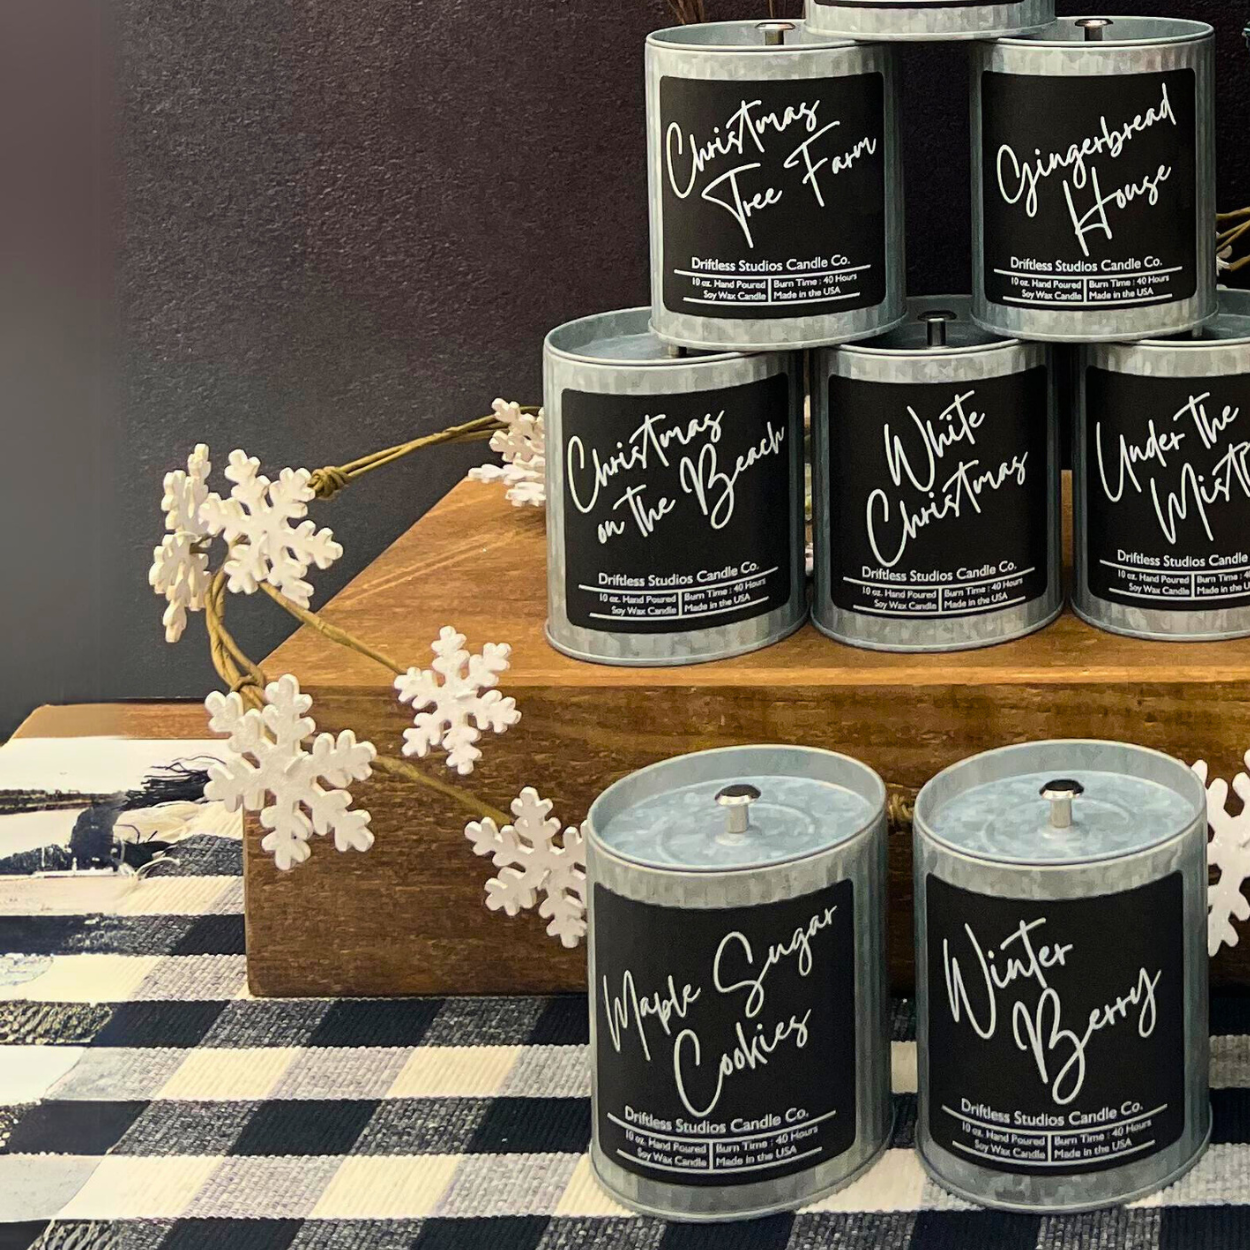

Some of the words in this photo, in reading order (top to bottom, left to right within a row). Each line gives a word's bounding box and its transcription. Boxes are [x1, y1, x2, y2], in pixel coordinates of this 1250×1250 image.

[666, 99, 821, 199] Christmas
[996, 82, 1177, 218] Gingerbread
[701, 162, 783, 249] Tree
[783, 120, 877, 207] Farm
[1063, 164, 1172, 257] House
[691, 256, 736, 271] Driftless
[738, 260, 783, 272] Studios
[786, 256, 828, 271] Candle
[830, 254, 850, 266] Co.
[1010, 256, 1053, 271] Driftless
[1055, 259, 1098, 272] Studios
[1100, 257, 1141, 271] Candle
[1143, 255, 1163, 268] Co.
[773, 280, 794, 288] Burn
[795, 278, 817, 287] Time
[823, 276, 834, 284] 40
[834, 273, 857, 283] Hours
[1089, 280, 1109, 289] Burn
[1109, 279, 1131, 288] Time
[1136, 277, 1147, 285] 40
[1148, 275, 1170, 283] Hours
[718, 291, 736, 300] Wax
[737, 291, 766, 300] Candle
[773, 291, 797, 300] Made
[799, 290, 807, 298] in
[808, 289, 822, 297] the
[822, 286, 841, 296] USA
[1035, 291, 1053, 299] Wax
[1054, 291, 1082, 300] Candle
[1089, 291, 1112, 300] Made
[1113, 290, 1121, 298] in
[1122, 289, 1135, 298] the
[1136, 287, 1154, 296] USA
[883, 390, 986, 492] White
[1096, 419, 1186, 502] Under
[1173, 391, 1239, 449] the
[567, 410, 725, 513] Christmas
[597, 520, 625, 544] on
[612, 484, 676, 538] the
[679, 421, 785, 530] Beach
[866, 451, 1029, 567] Christmas
[1117, 549, 1161, 566] Driftless
[1163, 555, 1206, 568] Studios
[1208, 551, 1248, 566] Candle
[598, 572, 645, 587] Driftless
[648, 573, 693, 587] Studios
[696, 566, 738, 582] Candle
[740, 561, 760, 574] Co.
[861, 566, 907, 581] Driftless
[909, 569, 953, 582] Studios
[956, 564, 996, 580] Candle
[998, 560, 1017, 573] Co.
[1196, 575, 1216, 583] Burn
[1218, 573, 1238, 582] Time
[684, 592, 705, 601] Burn
[706, 589, 728, 598] Time
[733, 582, 744, 592] 40
[744, 578, 766, 589] Hours
[944, 589, 964, 598] Burn
[965, 587, 986, 595] Time
[991, 581, 1002, 591] 40
[1002, 578, 1023, 588] Hours
[1142, 584, 1161, 594] Wax
[1162, 586, 1190, 595] Candle
[1196, 586, 1219, 595] Made
[1220, 584, 1228, 593] in
[1229, 583, 1242, 592] the
[684, 603, 708, 612] Made
[709, 601, 718, 610] in
[718, 598, 732, 608] the
[733, 593, 751, 604] USA
[888, 601, 907, 610] Wax
[908, 601, 937, 610] Candle
[944, 600, 967, 609] Made
[968, 598, 976, 607] in
[977, 596, 990, 605] the
[991, 592, 1008, 601] USA
[603, 969, 702, 1061] Maple
[713, 905, 838, 1018] Sugar
[943, 917, 1074, 1040] Winter
[1012, 967, 1162, 1105] Berry
[673, 1008, 812, 1118] Cookies
[624, 1105, 672, 1131] Driftless
[675, 1118, 726, 1135] Studios
[730, 1113, 782, 1133] Candle
[784, 1107, 809, 1122] Co.
[961, 1098, 1010, 1124] Driftless
[1014, 1111, 1065, 1127] Studios
[1068, 1106, 1118, 1125] Candle
[1120, 1101, 1143, 1116] Co.
[716, 1144, 740, 1154] Burn
[741, 1140, 768, 1151] Time
[775, 1134, 789, 1145] 40
[790, 1126, 818, 1141] Hours
[1054, 1135, 1079, 1146] Burn
[1079, 1132, 1105, 1144] Time
[1111, 1126, 1124, 1137] 40
[1125, 1119, 1152, 1134] Hours
[716, 1156, 744, 1167] Made
[745, 1154, 756, 1164] in
[757, 1151, 774, 1162] the
[775, 1145, 797, 1158] USA
[1054, 1148, 1081, 1159] Made
[1083, 1146, 1093, 1156] in
[1094, 1144, 1110, 1155] the
[1111, 1138, 1132, 1150] USA
